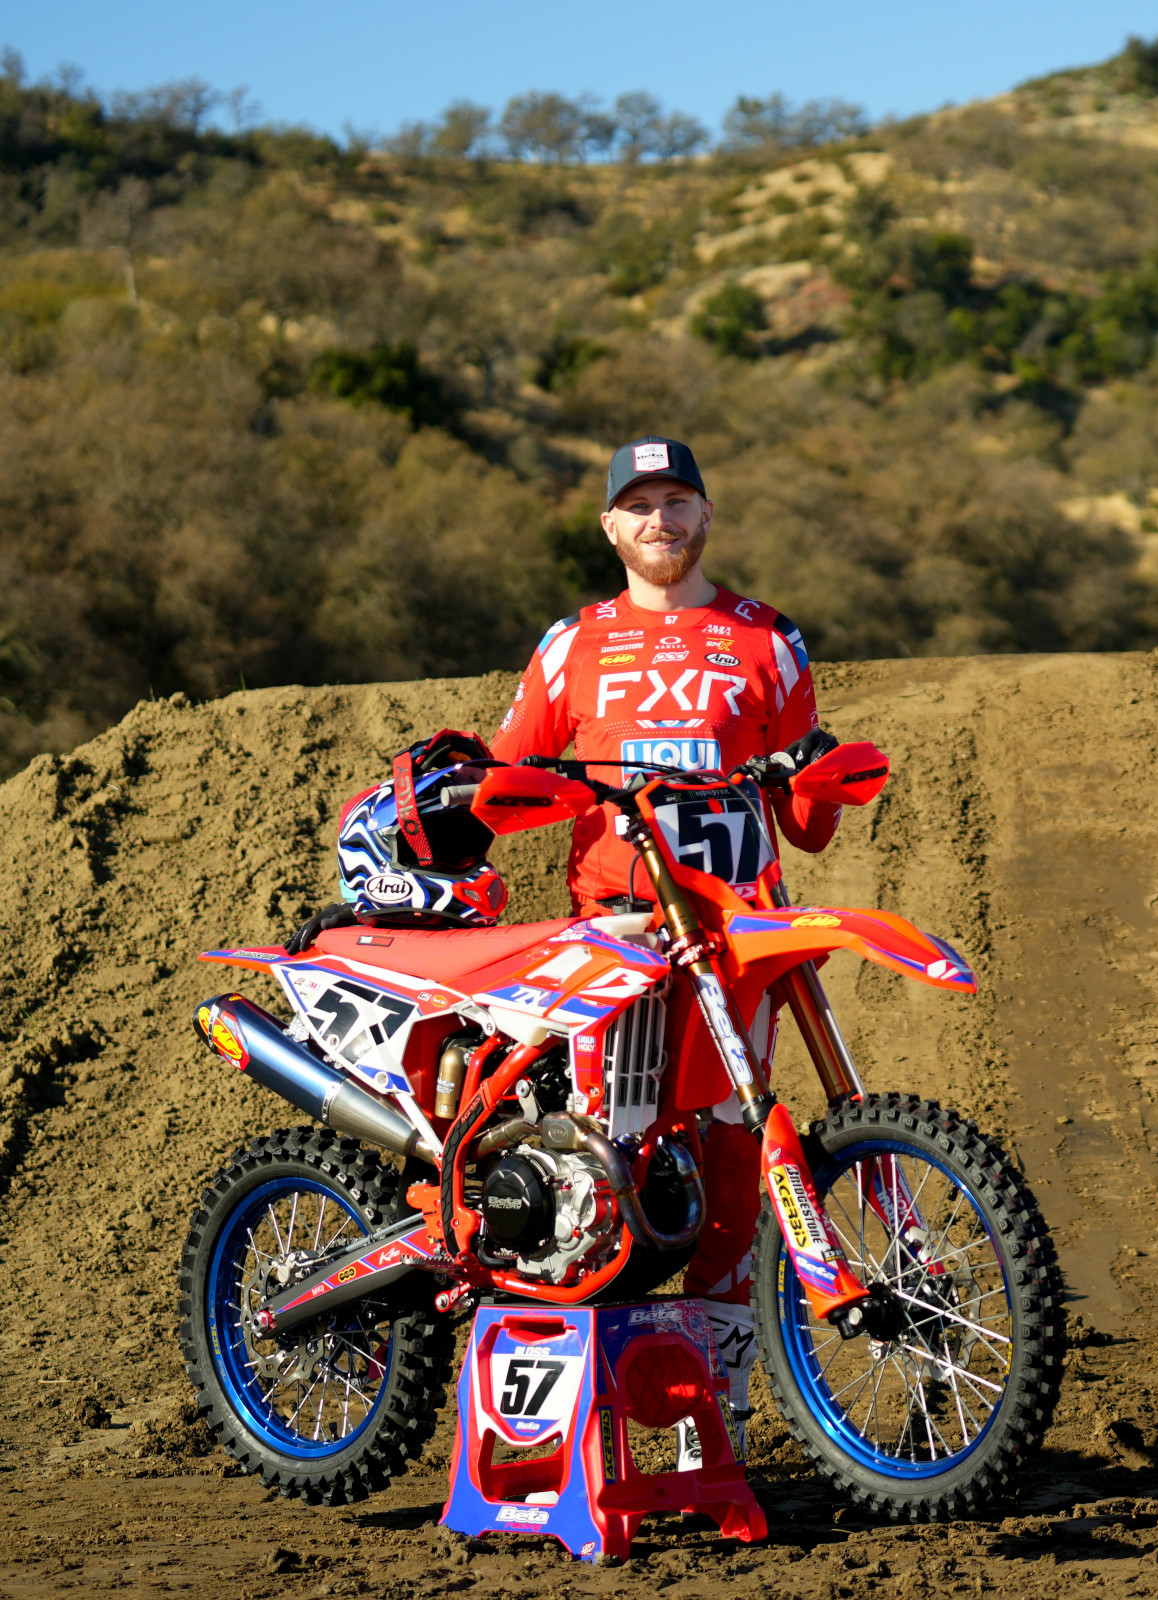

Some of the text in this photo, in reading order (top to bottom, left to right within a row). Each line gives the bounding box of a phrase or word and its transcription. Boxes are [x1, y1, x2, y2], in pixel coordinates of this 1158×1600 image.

[665, 615, 679, 625] 57
[608, 630, 645, 640] Beta
[702, 624, 732, 636] AMA
[600, 643, 645, 653] BRIDGESTONE
[706, 640, 735, 652] SMX
[599, 654, 636, 666] FMF
[652, 651, 690, 664] pod
[596, 669, 748, 718] FXR
[626, 741, 717, 772] LIQUI
[695, 788, 730, 797] MONSTER
[677, 799, 761, 884] 57
[369, 879, 408, 895] Arai
[790, 914, 843, 928] FMF
[306, 979, 417, 1065] 57
[577, 1035, 597, 1044] LIQUI
[700, 979, 754, 1086] Beta
[577, 1043, 597, 1052] MOLY
[488, 1195, 522, 1204] Beta
[783, 1162, 824, 1245] BRIDGESTONE
[772, 1170, 808, 1248] ACERBIS
[778, 1258, 786, 1293] EXCEL
[796, 1255, 837, 1280] Beta
[628, 1308, 682, 1326] Beta
[211, 1323, 221, 1355] EXCEL
[514, 1346, 551, 1359] BLOSS
[499, 1359, 566, 1416] 57
[515, 1421, 541, 1431] Beta
[601, 1410, 615, 1478] ACERBIS
[497, 1506, 550, 1525] Beta
